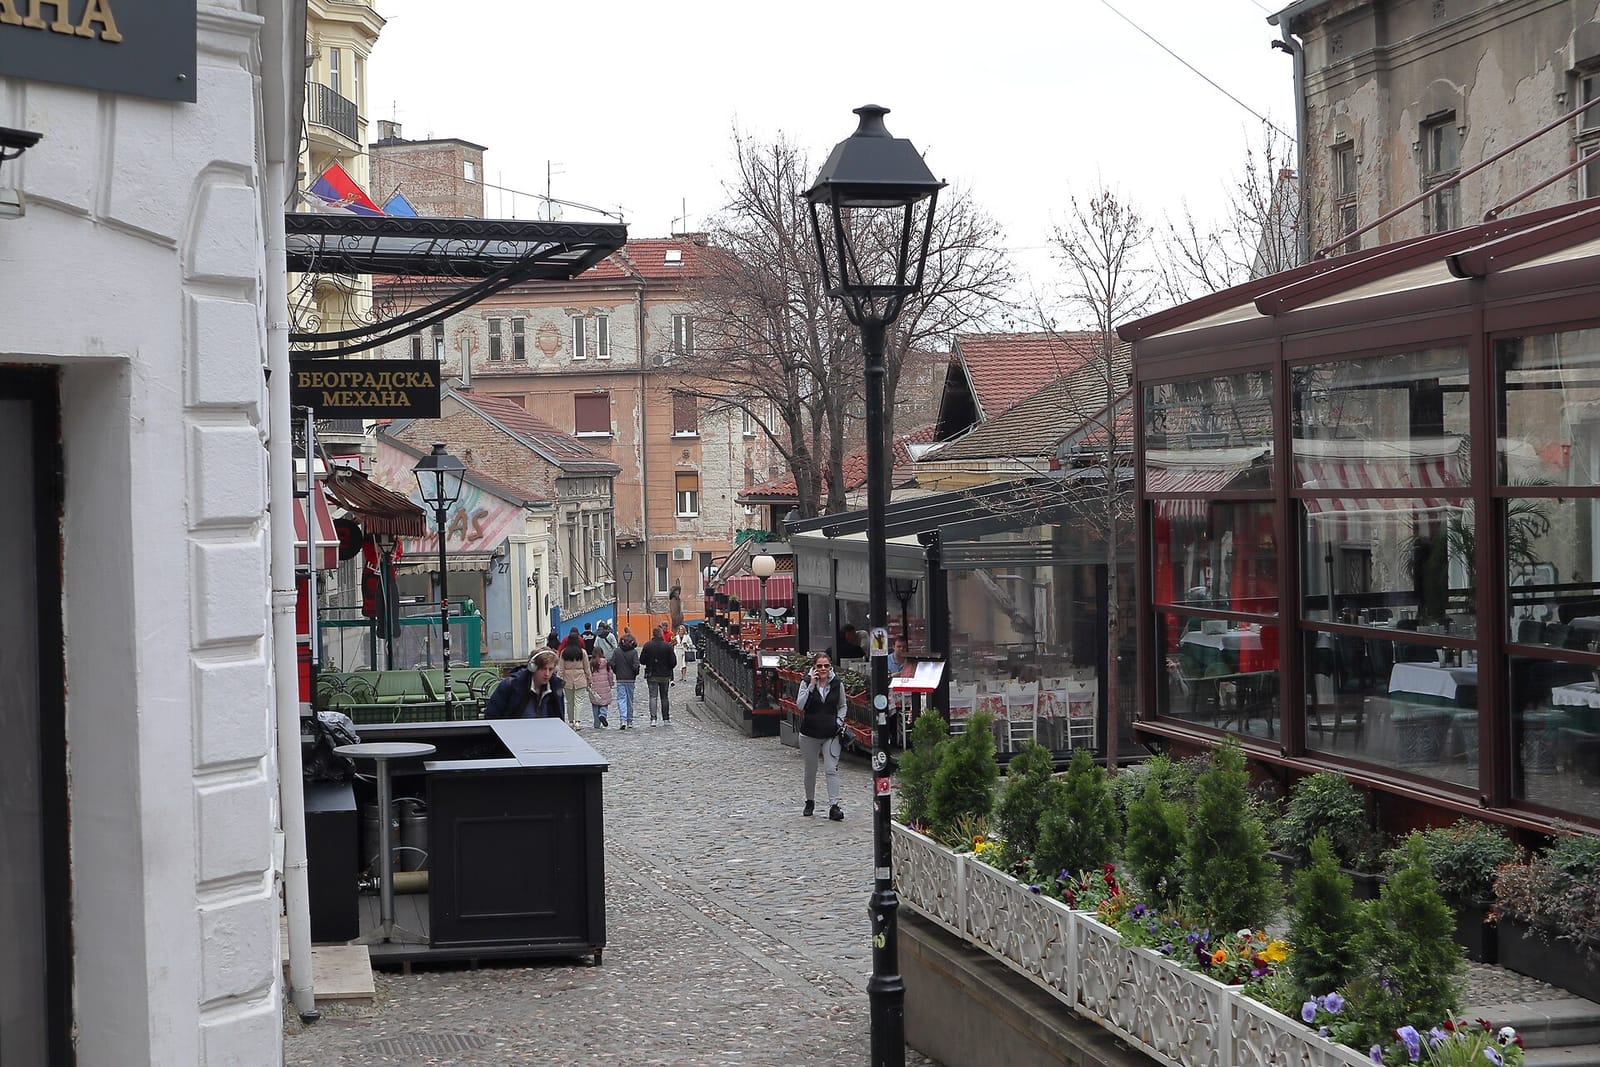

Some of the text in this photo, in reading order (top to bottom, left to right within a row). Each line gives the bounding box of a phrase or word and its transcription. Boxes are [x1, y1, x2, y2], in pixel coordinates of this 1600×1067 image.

[297, 371, 436, 391] БЕОГРАДСКА
[322, 391, 412, 407] МЕХАНА
[498, 562, 510, 574] 27
